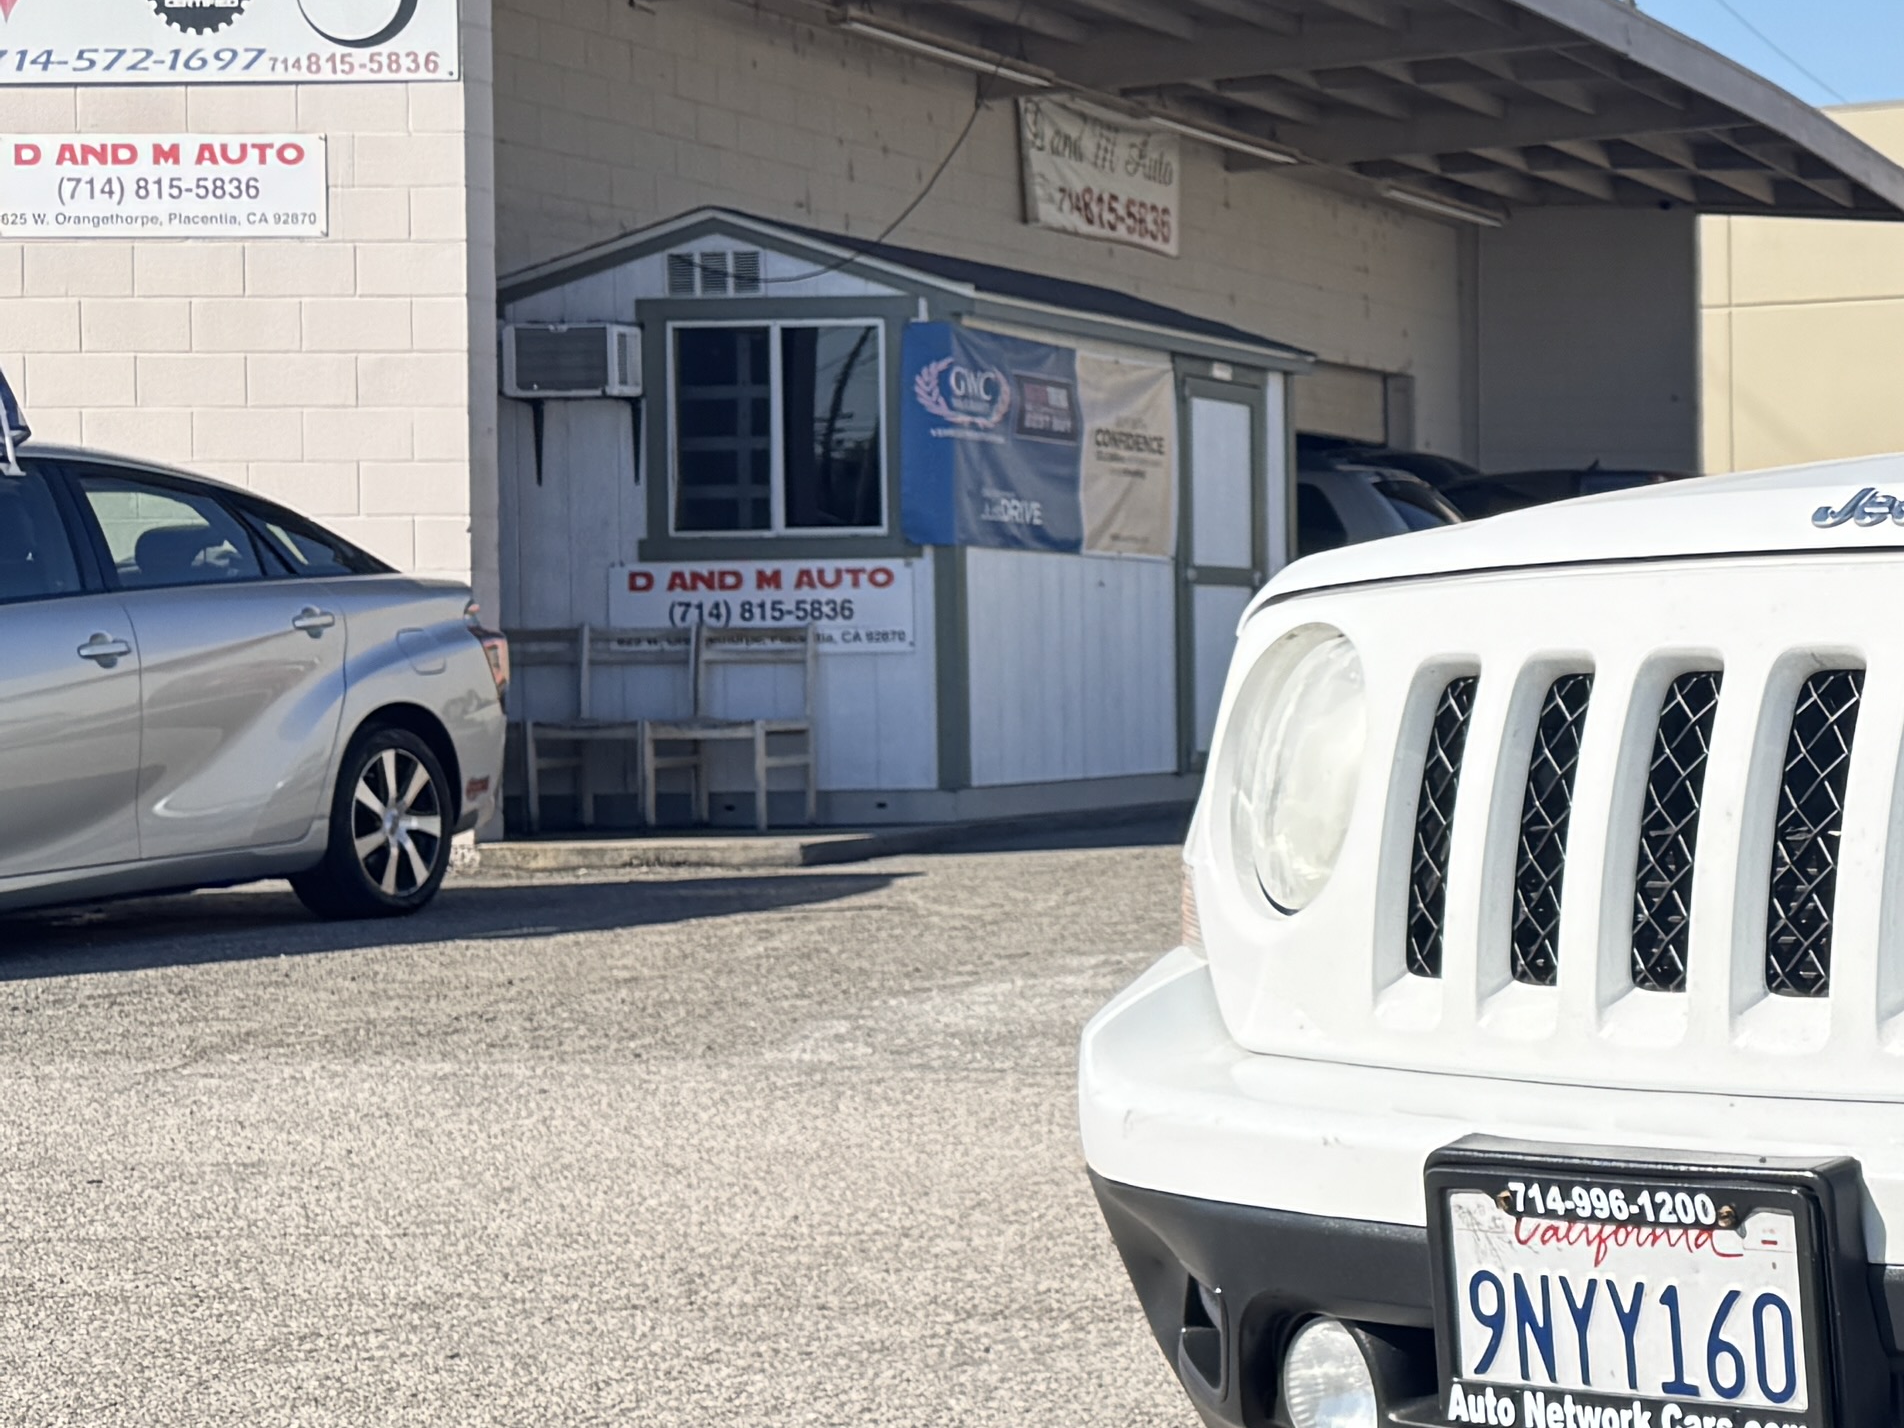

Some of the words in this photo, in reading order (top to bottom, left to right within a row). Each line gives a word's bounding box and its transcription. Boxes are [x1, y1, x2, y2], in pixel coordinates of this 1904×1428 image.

[14, 143, 42, 165] D
[55, 143, 139, 165] AND
[152, 143, 181, 165] M
[195, 142, 305, 165] AUTO
[1125, 137, 1174, 188] Auto
[57, 175, 125, 205] (714)
[134, 176, 260, 200] 815-5836
[55, 212, 163, 229] Orangethorpe,
[168, 212, 242, 227] Placentia,
[246, 212, 269, 226] CA
[273, 212, 317, 226] 92870
[1095, 428, 1165, 457] CONFIDENCE
[1001, 498, 1043, 526] DRIVE
[628, 571, 654, 592] D
[667, 570, 743, 592] AND
[756, 569, 783, 591] M
[794, 566, 895, 590] AUTO
[668, 600, 731, 629] (714)
[739, 598, 855, 622] 815-5836
[1507, 1181, 1717, 1226] 714-996-1200
[1469, 1269, 1796, 1404] 9NYY160
[1448, 1385, 1516, 1428] Auto
